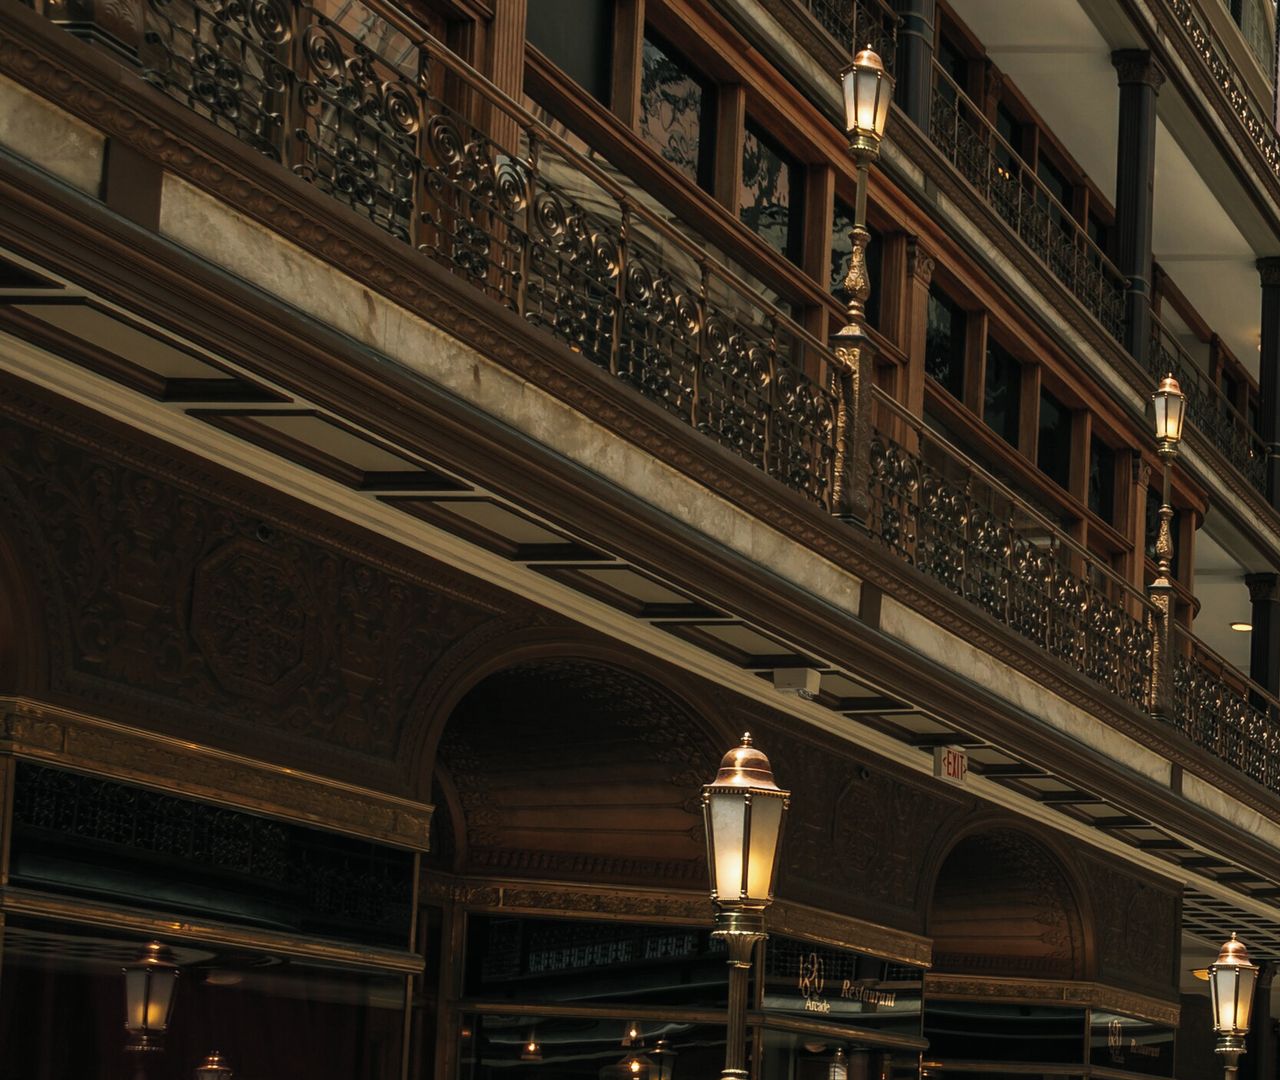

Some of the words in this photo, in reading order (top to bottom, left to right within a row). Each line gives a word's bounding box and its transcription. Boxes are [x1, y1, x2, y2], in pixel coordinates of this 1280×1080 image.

[947, 750, 964, 780] EXIT
[804, 998, 831, 1014] Arcade
[841, 979, 897, 1007] Restaurant
